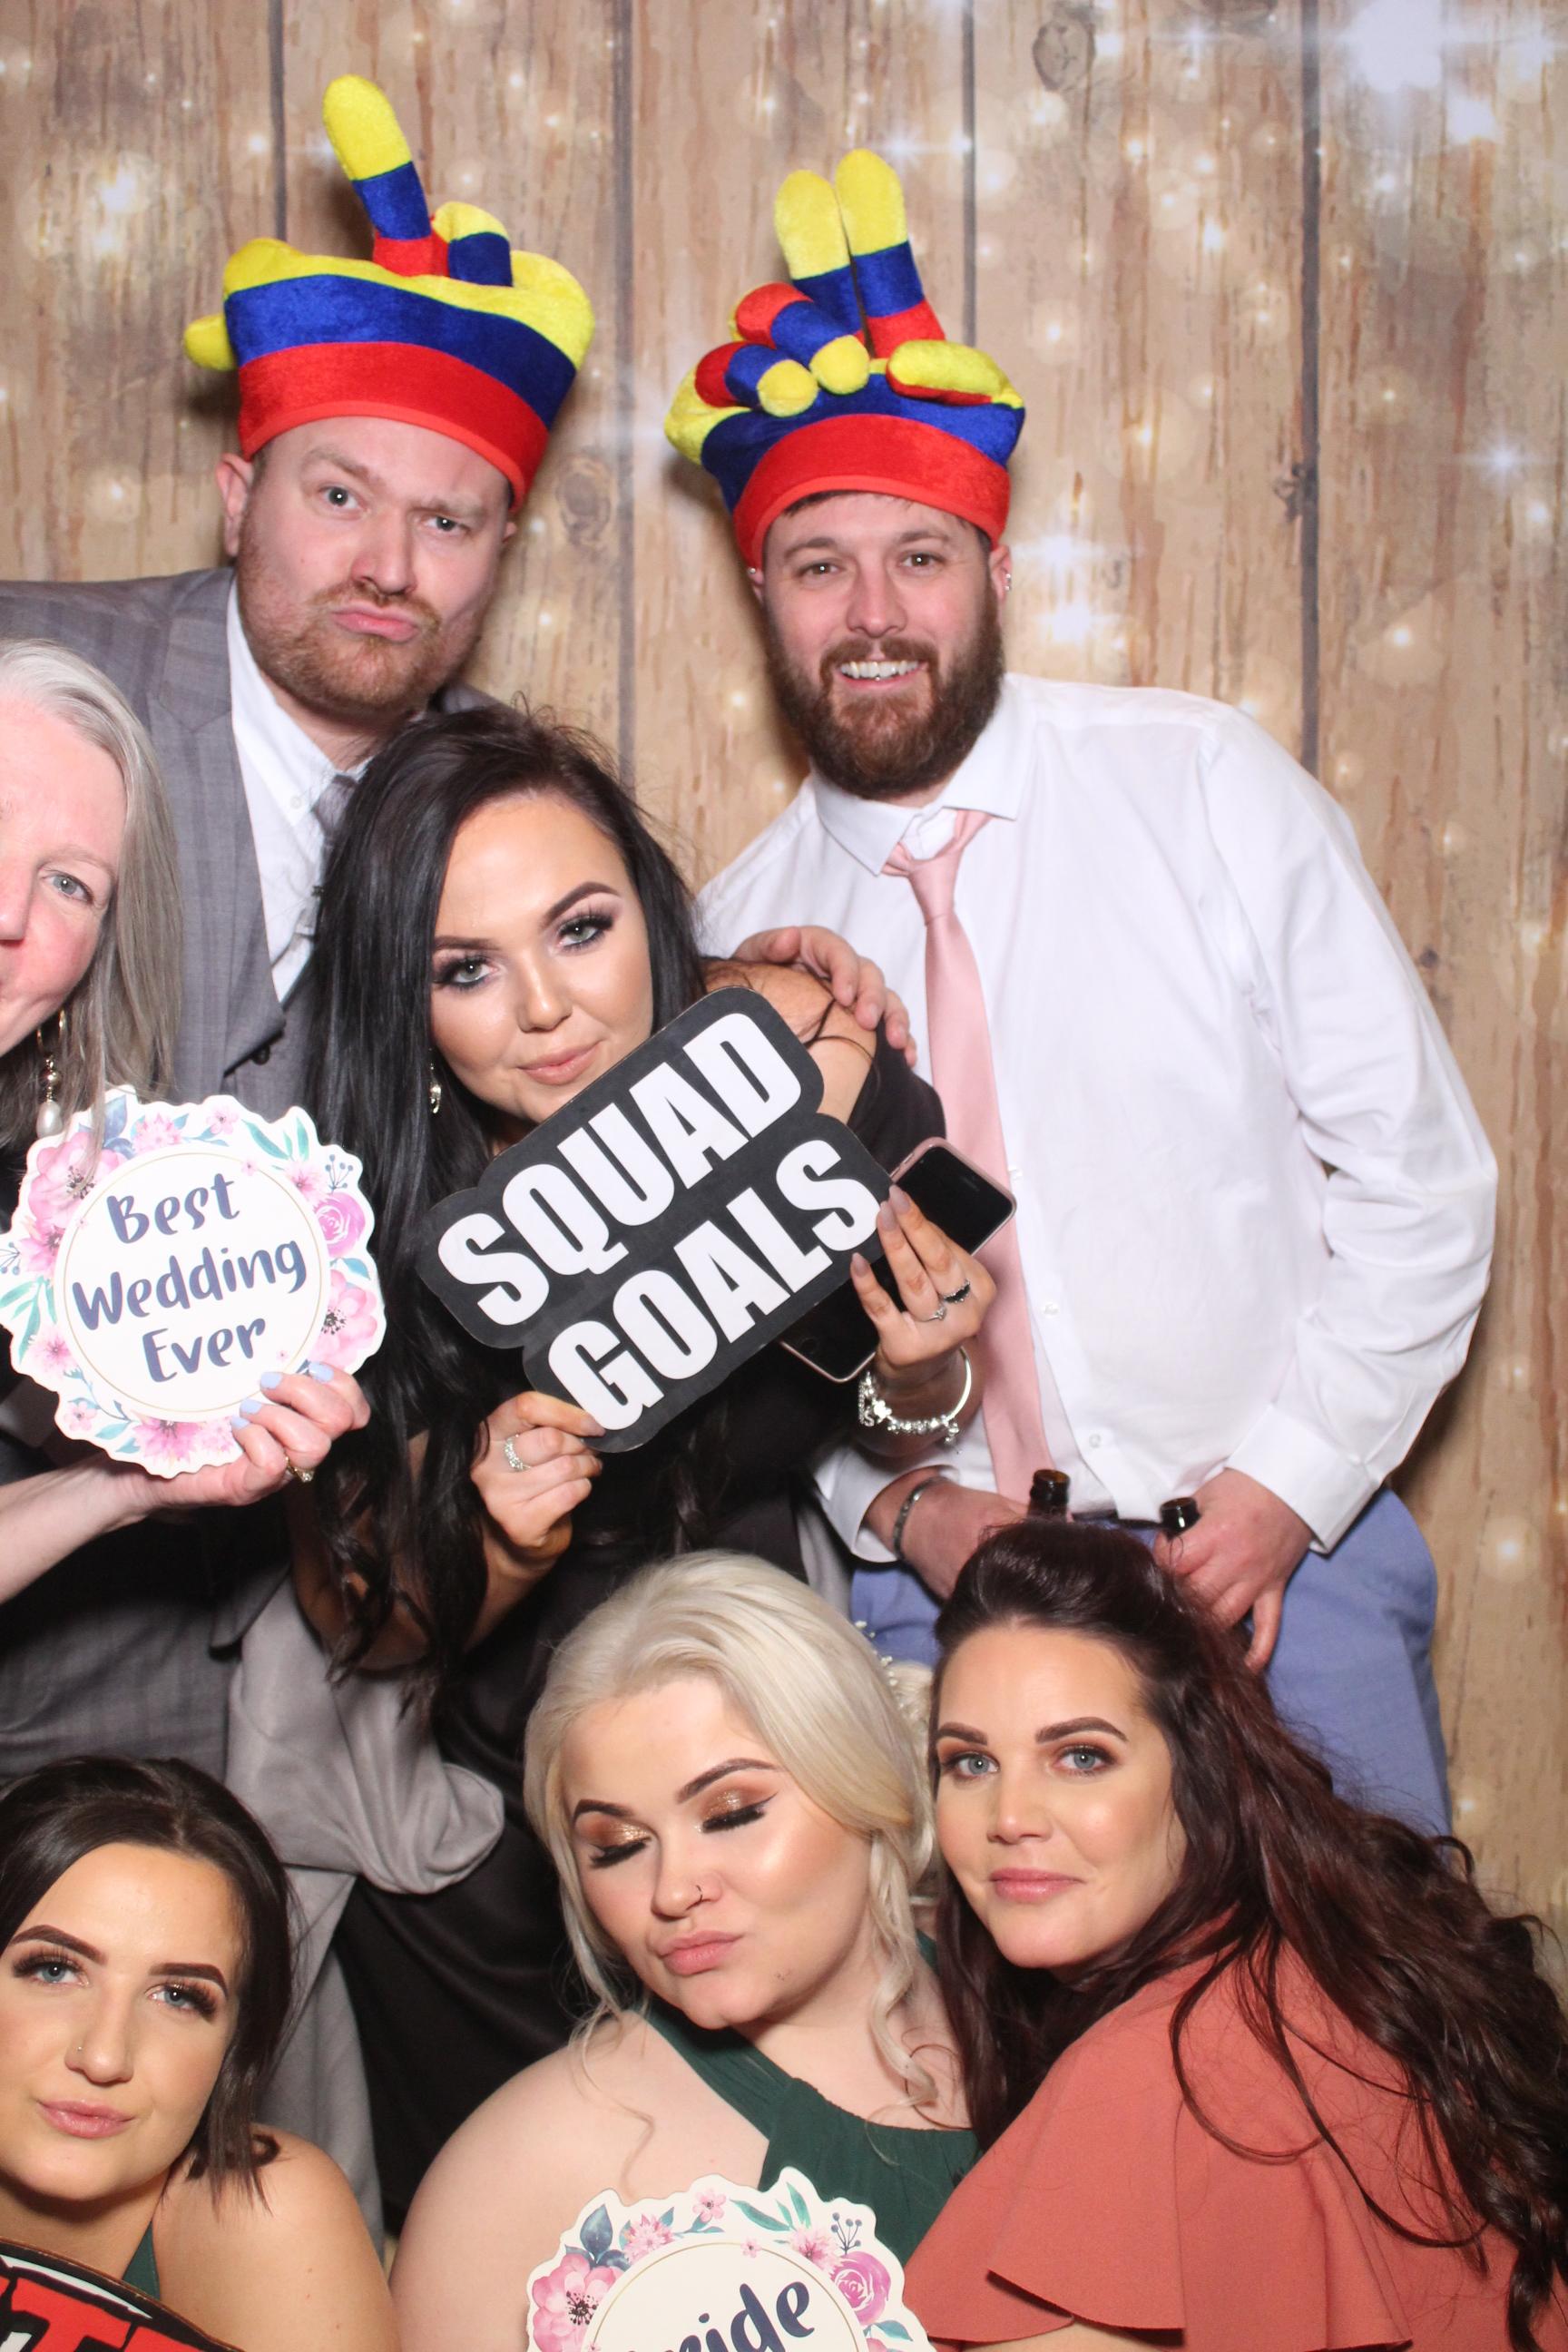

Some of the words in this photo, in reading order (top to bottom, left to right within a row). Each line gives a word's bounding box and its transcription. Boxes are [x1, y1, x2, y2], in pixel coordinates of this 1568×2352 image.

[106, 1173, 240, 1244] Best
[437, 1012, 802, 1326] SQUAD
[72, 1240, 307, 1330] Wedding
[548, 1139, 881, 1430] GOALS
[142, 1318, 266, 1382] Ever
[630, 2281, 815, 2352] ide
